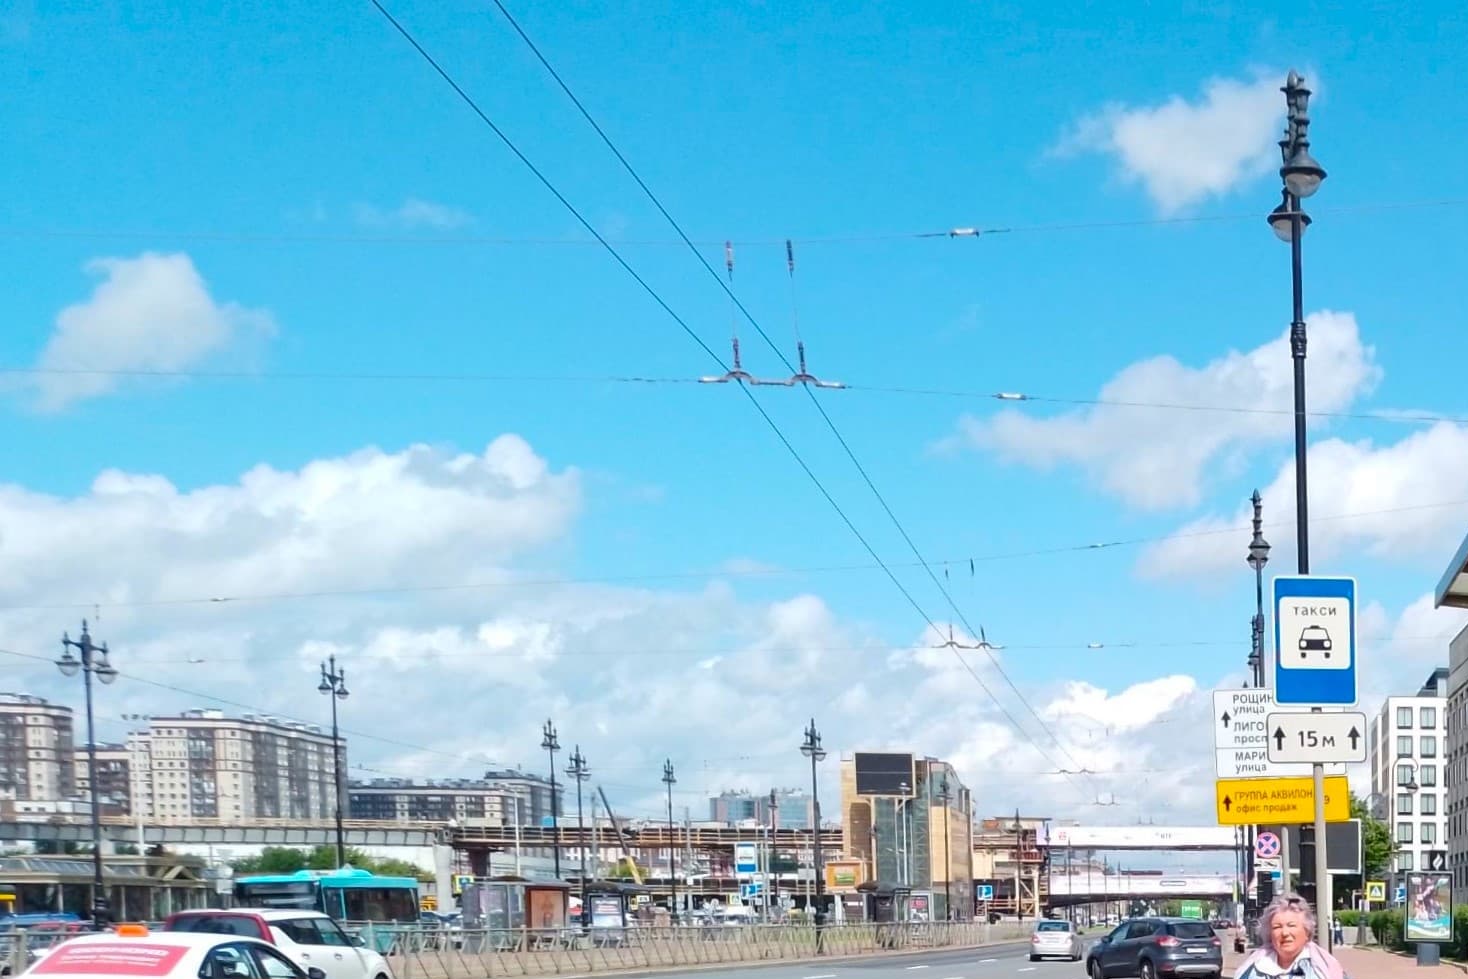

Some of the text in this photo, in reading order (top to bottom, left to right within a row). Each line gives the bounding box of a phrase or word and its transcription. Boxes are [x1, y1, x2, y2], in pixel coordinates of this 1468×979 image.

[1293, 606, 1337, 617] такси
[1232, 705, 1265, 716] улица
[1298, 730, 1336, 748] 15 м
[1235, 762, 1267, 774] улица
[1234, 788, 1313, 801] ГРУППА АКВИЛОН
[1236, 803, 1298, 814] офис продаж
